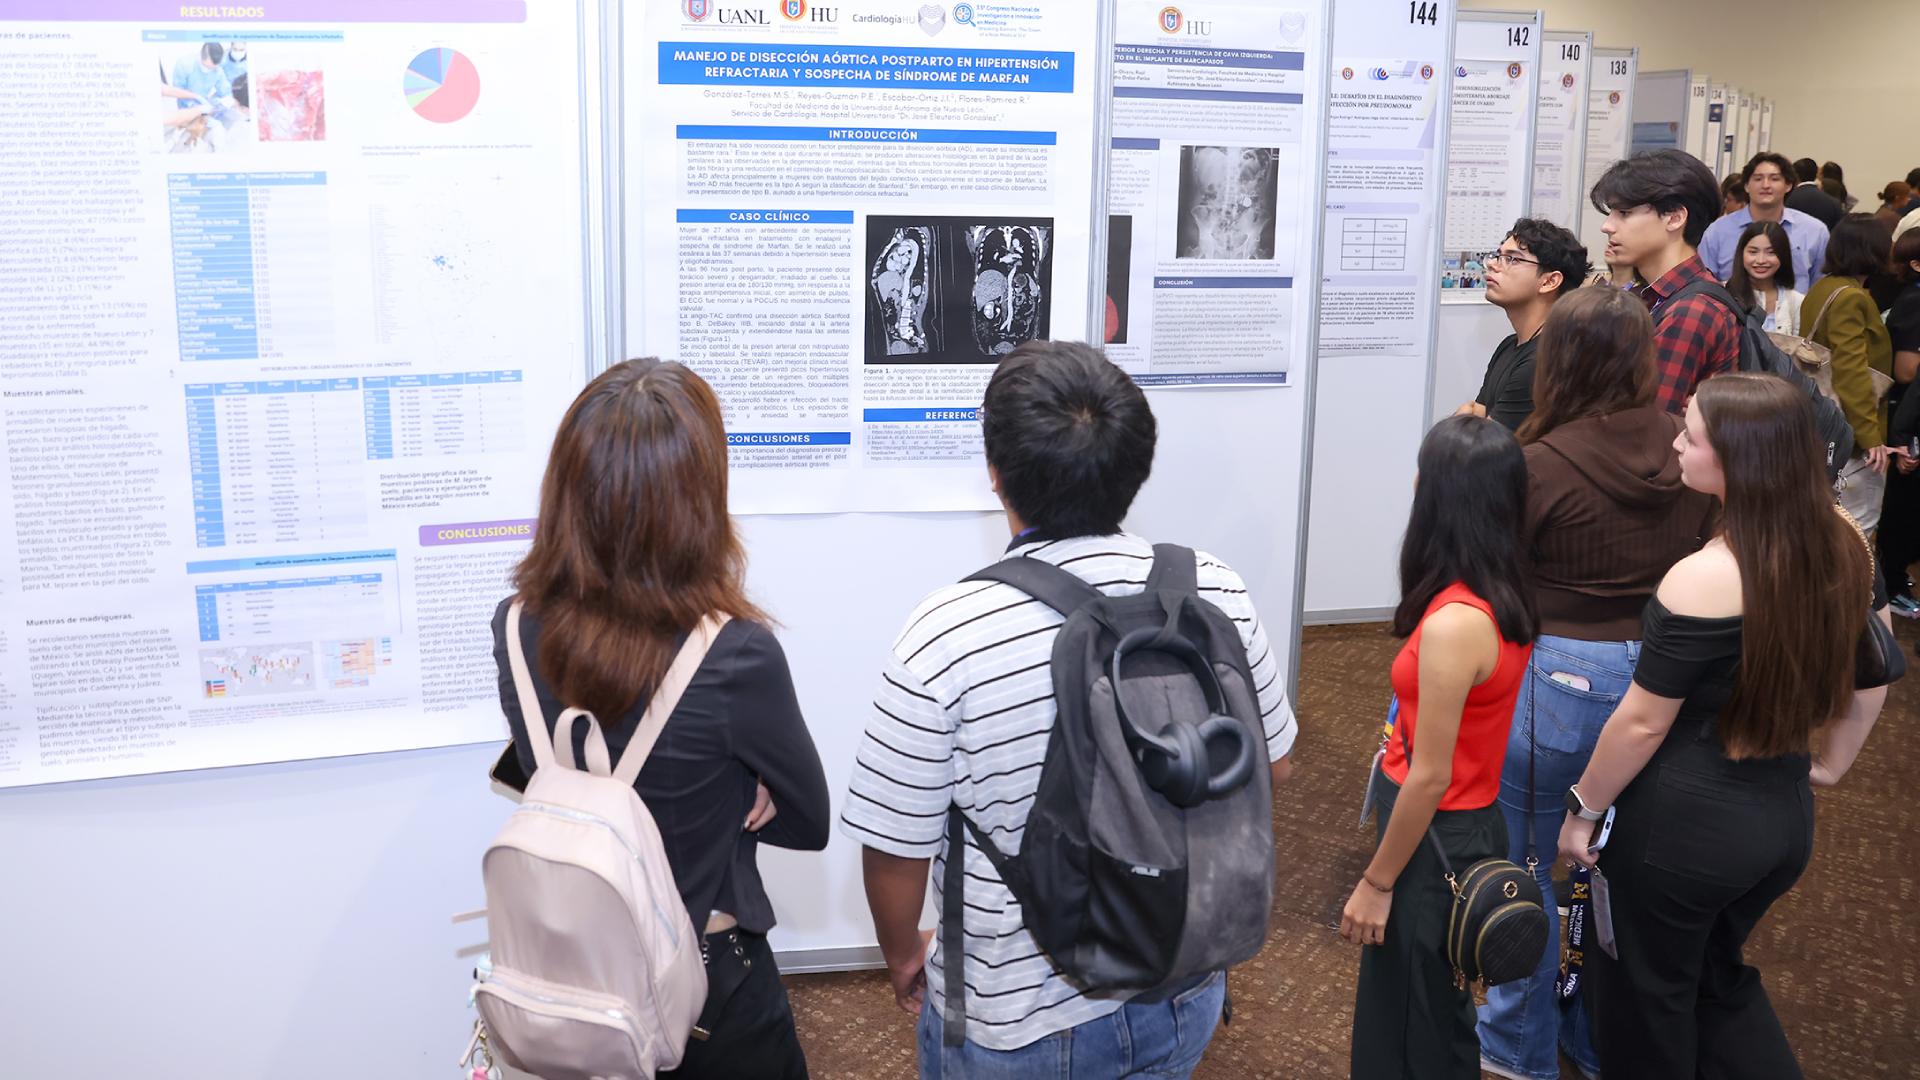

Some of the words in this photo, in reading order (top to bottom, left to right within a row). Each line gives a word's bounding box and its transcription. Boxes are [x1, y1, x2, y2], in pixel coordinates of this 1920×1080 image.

[180, 6, 264, 18] RESULTADOS
[718, 9, 770, 24] UANL
[811, 7, 838, 22] HU
[1411, 1, 1437, 26] 144
[1187, 20, 1212, 35] HU
[1509, 26, 1528, 47] 142
[674, 50, 727, 62] MANEJO
[731, 51, 745, 62] DE
[750, 50, 818, 64] DISECCIÓN
[823, 51, 877, 65] AÓRTICA
[882, 55, 953, 67] POSTPARTO
[958, 57, 971, 67] EN
[976, 56, 1058, 69] HIPERTENSIÓN
[1562, 44, 1580, 61] 140
[706, 66, 788, 78] REFRACTARIA
[805, 68, 871, 80] SOSPECHA
[876, 70, 890, 81] DE
[894, 68, 957, 82] SÍNDROME
[961, 72, 975, 83] DE
[979, 72, 1029, 84] MARFAN
[1611, 59, 1626, 76] 138
[830, 128, 917, 140] INTRODUCCIÓN
[730, 212, 761, 221] CASO
[765, 211, 809, 221] CLÍNICO
[864, 367, 883, 375] Figura
[3, 389, 43, 397] Muestras
[45, 388, 83, 396] animales.
[926, 411, 977, 419] REFERENC
[726, 435, 810, 443] CONCLUSIONES
[438, 524, 530, 540] CONCLUSIONES
[26, 617, 65, 626] Muestras
[80, 614, 132, 623] madrigueras.
